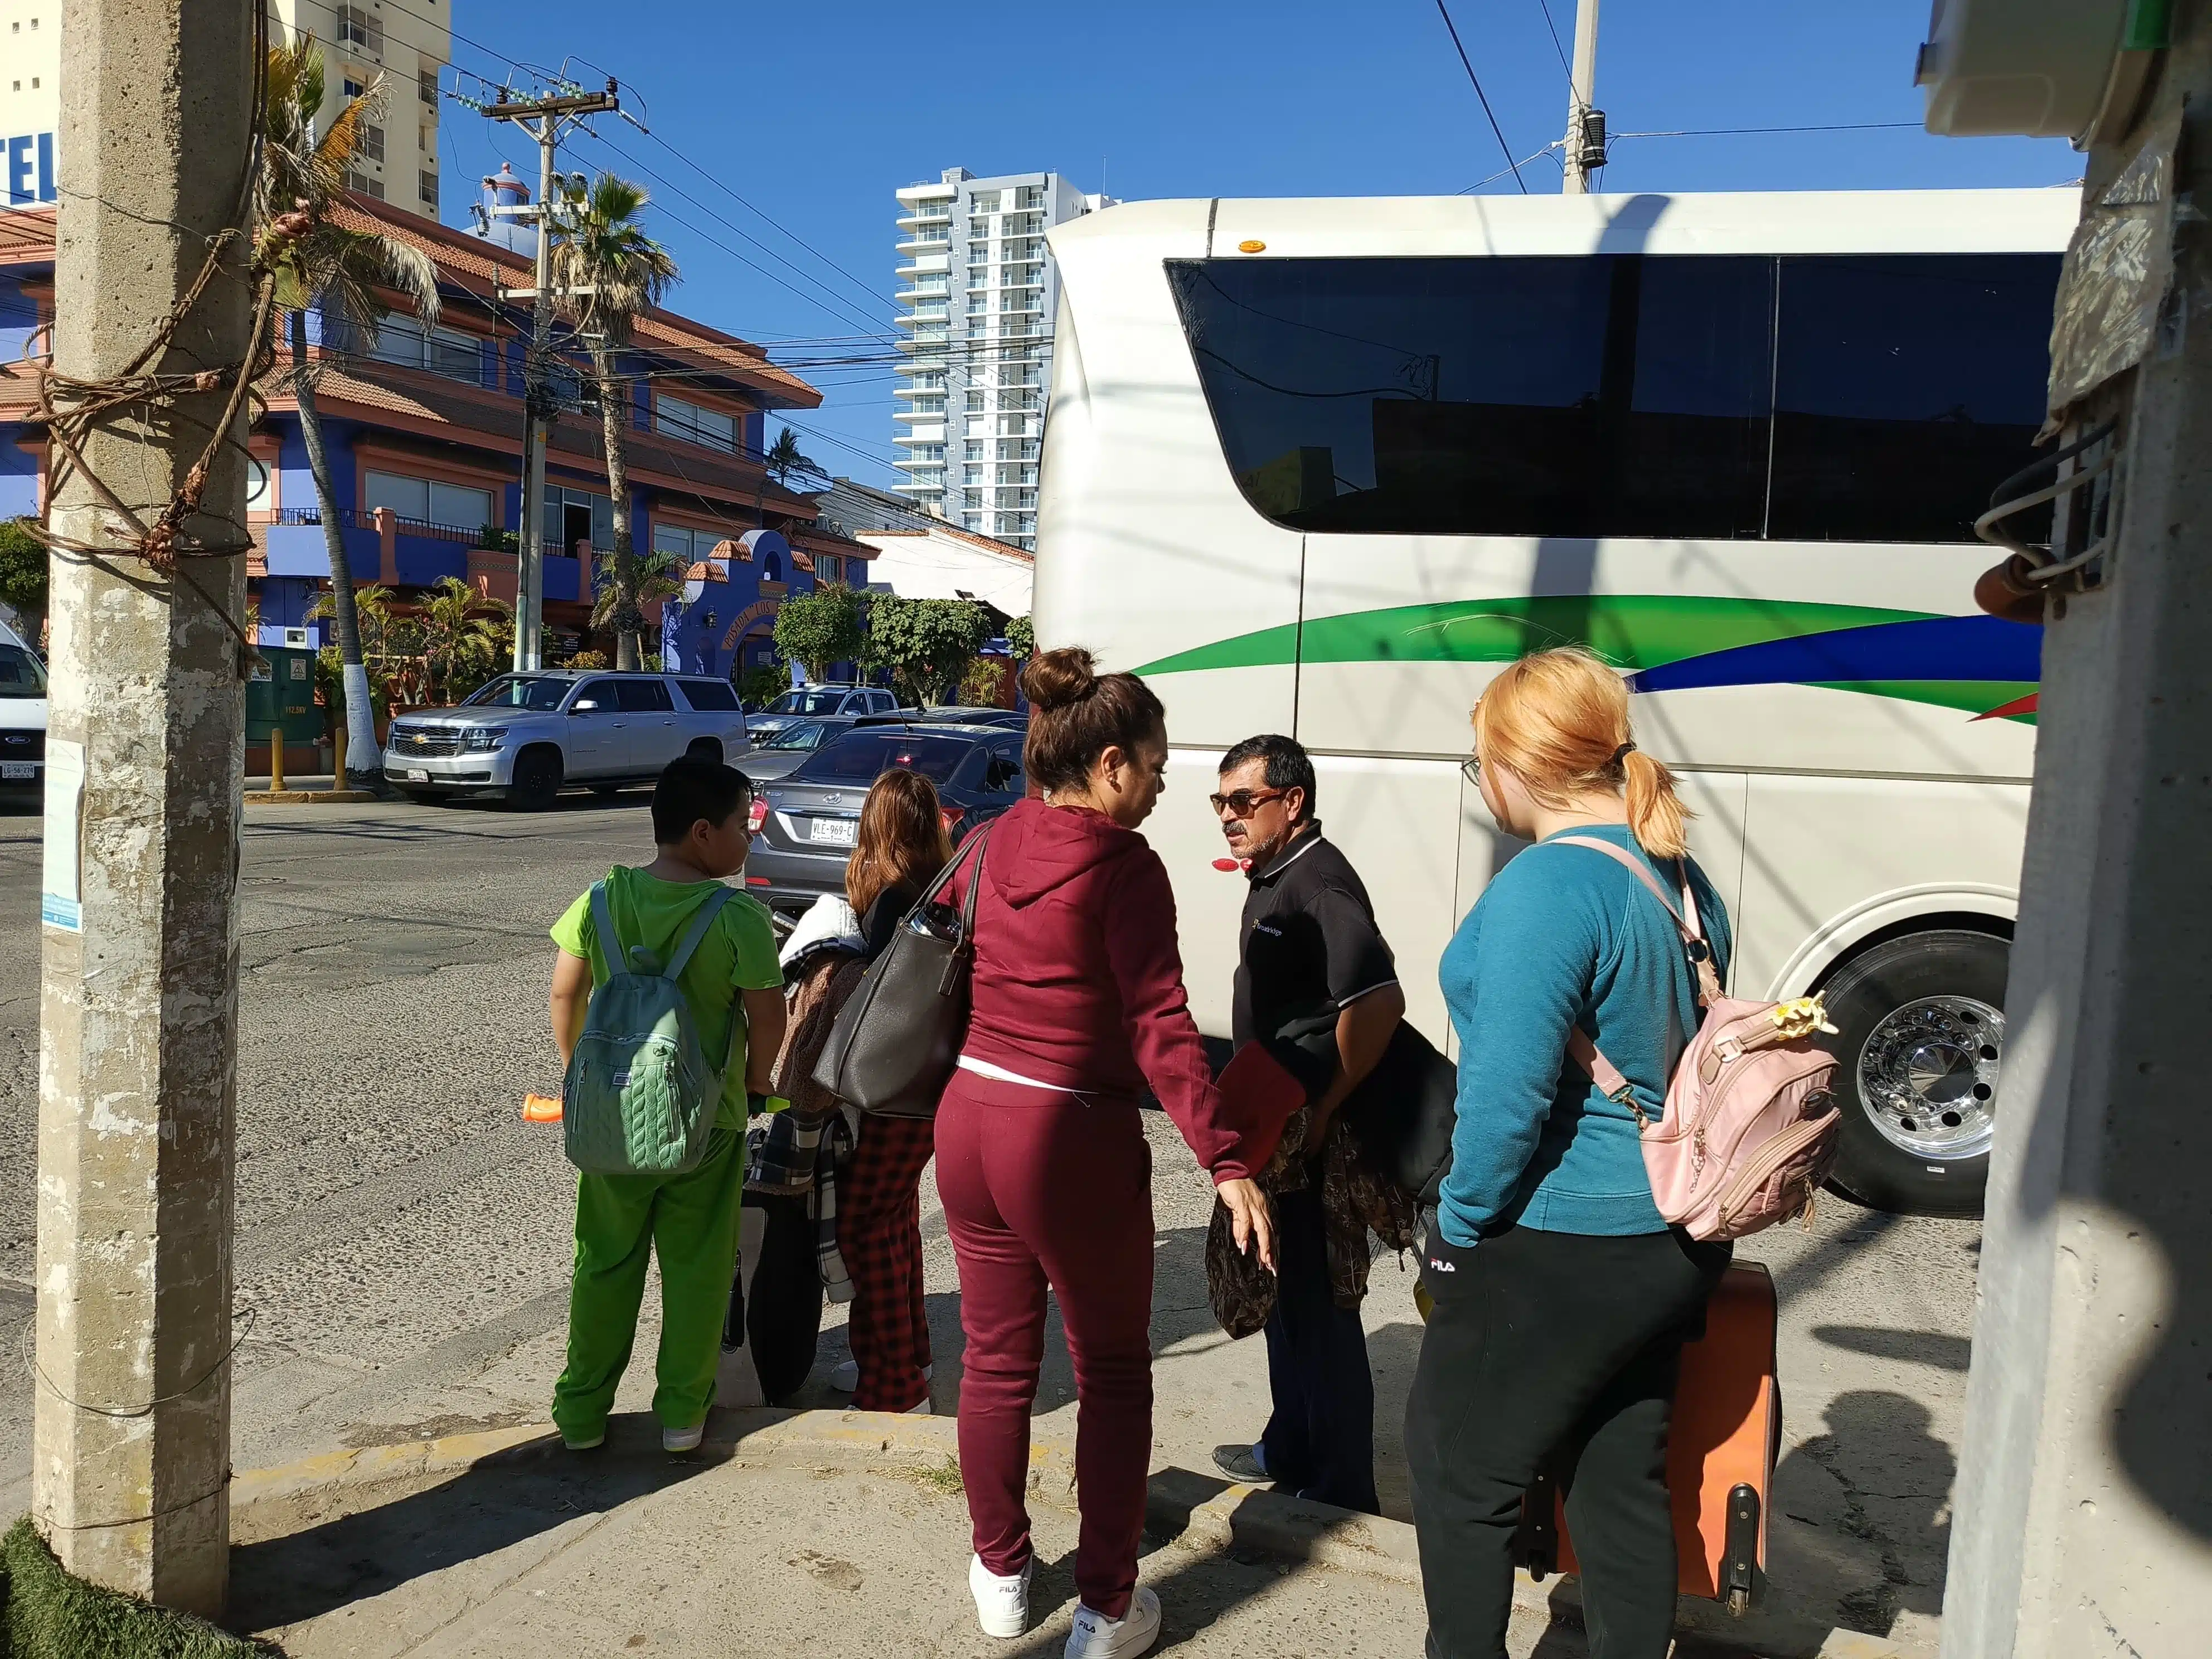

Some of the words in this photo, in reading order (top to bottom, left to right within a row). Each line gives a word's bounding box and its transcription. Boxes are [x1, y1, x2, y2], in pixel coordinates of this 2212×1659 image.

[0, 133, 57, 205] EL
[725, 611, 750, 648] POSADA
[813, 823, 852, 837] VLE-969-C
[1430, 1258, 1456, 1272] FILA
[1078, 1619, 1097, 1634] FILA
